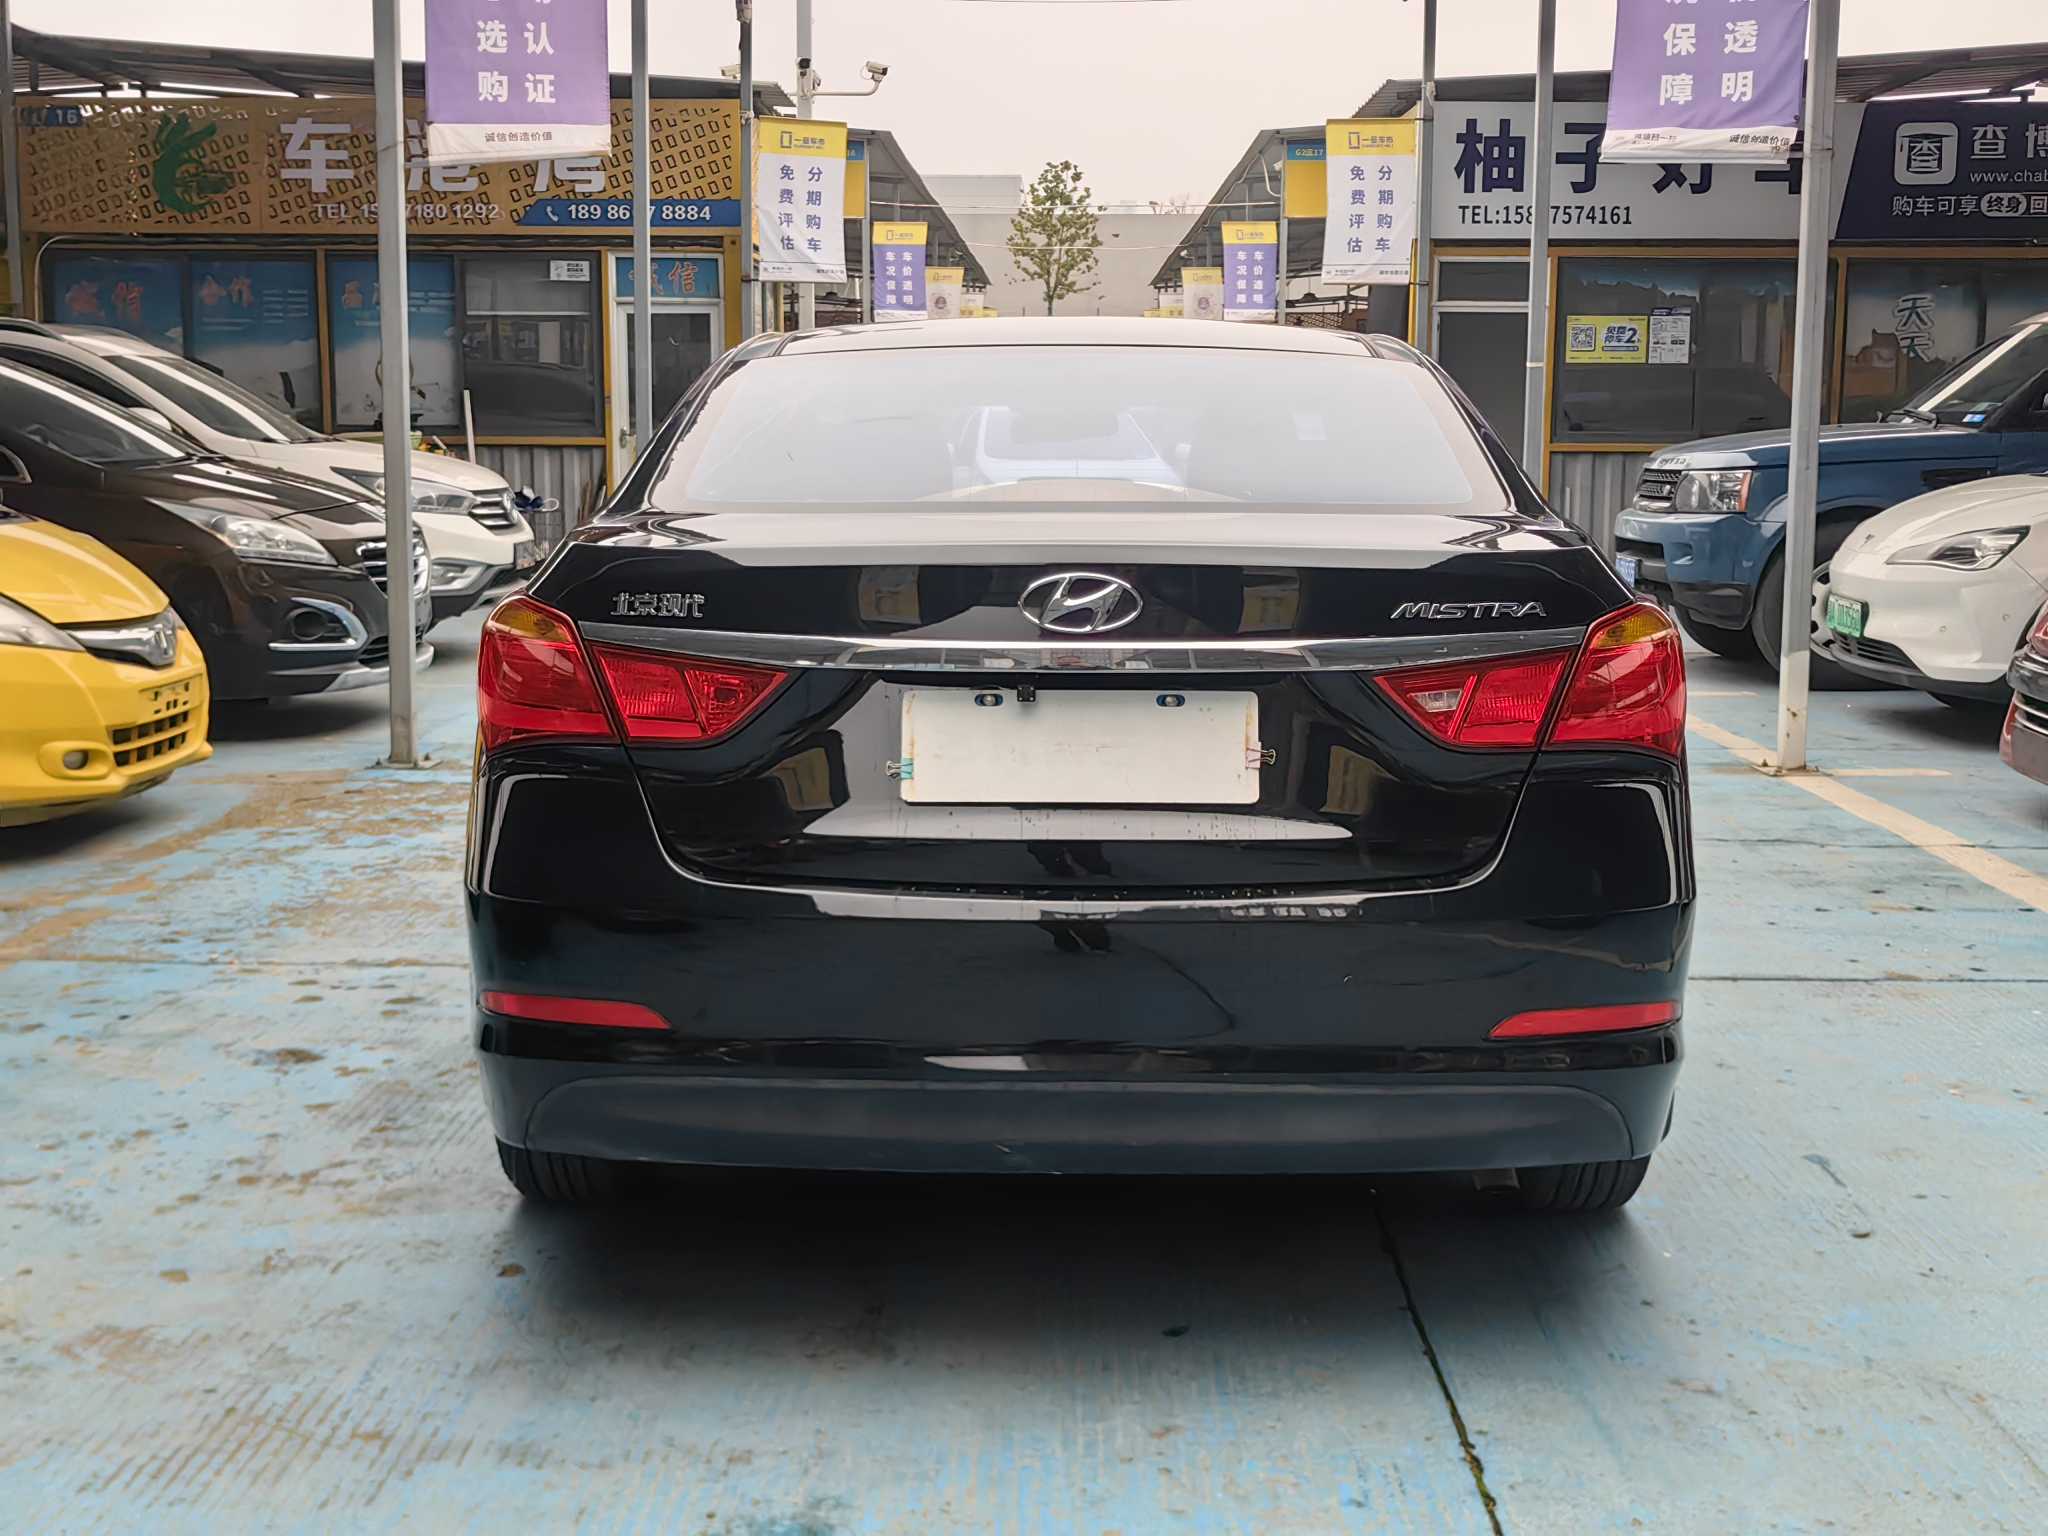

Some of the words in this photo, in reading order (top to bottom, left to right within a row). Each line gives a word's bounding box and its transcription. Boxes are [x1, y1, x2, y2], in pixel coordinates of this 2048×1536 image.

[484, 131, 553, 142] 诚信创造价值
[455, 204, 498, 218] 1292
[568, 205, 600, 219] 189
[662, 205, 711, 220] 8884
[778, 164, 794, 251] 免费评估
[806, 166, 823, 252] 分期购车
[1347, 165, 1366, 253] 免费评估
[1375, 165, 1394, 252] 分期购车
[1459, 205, 1632, 225] TEL:1587574161
[611, 592, 705, 618] 北京现代
[1391, 601, 1547, 619] MISTRA
